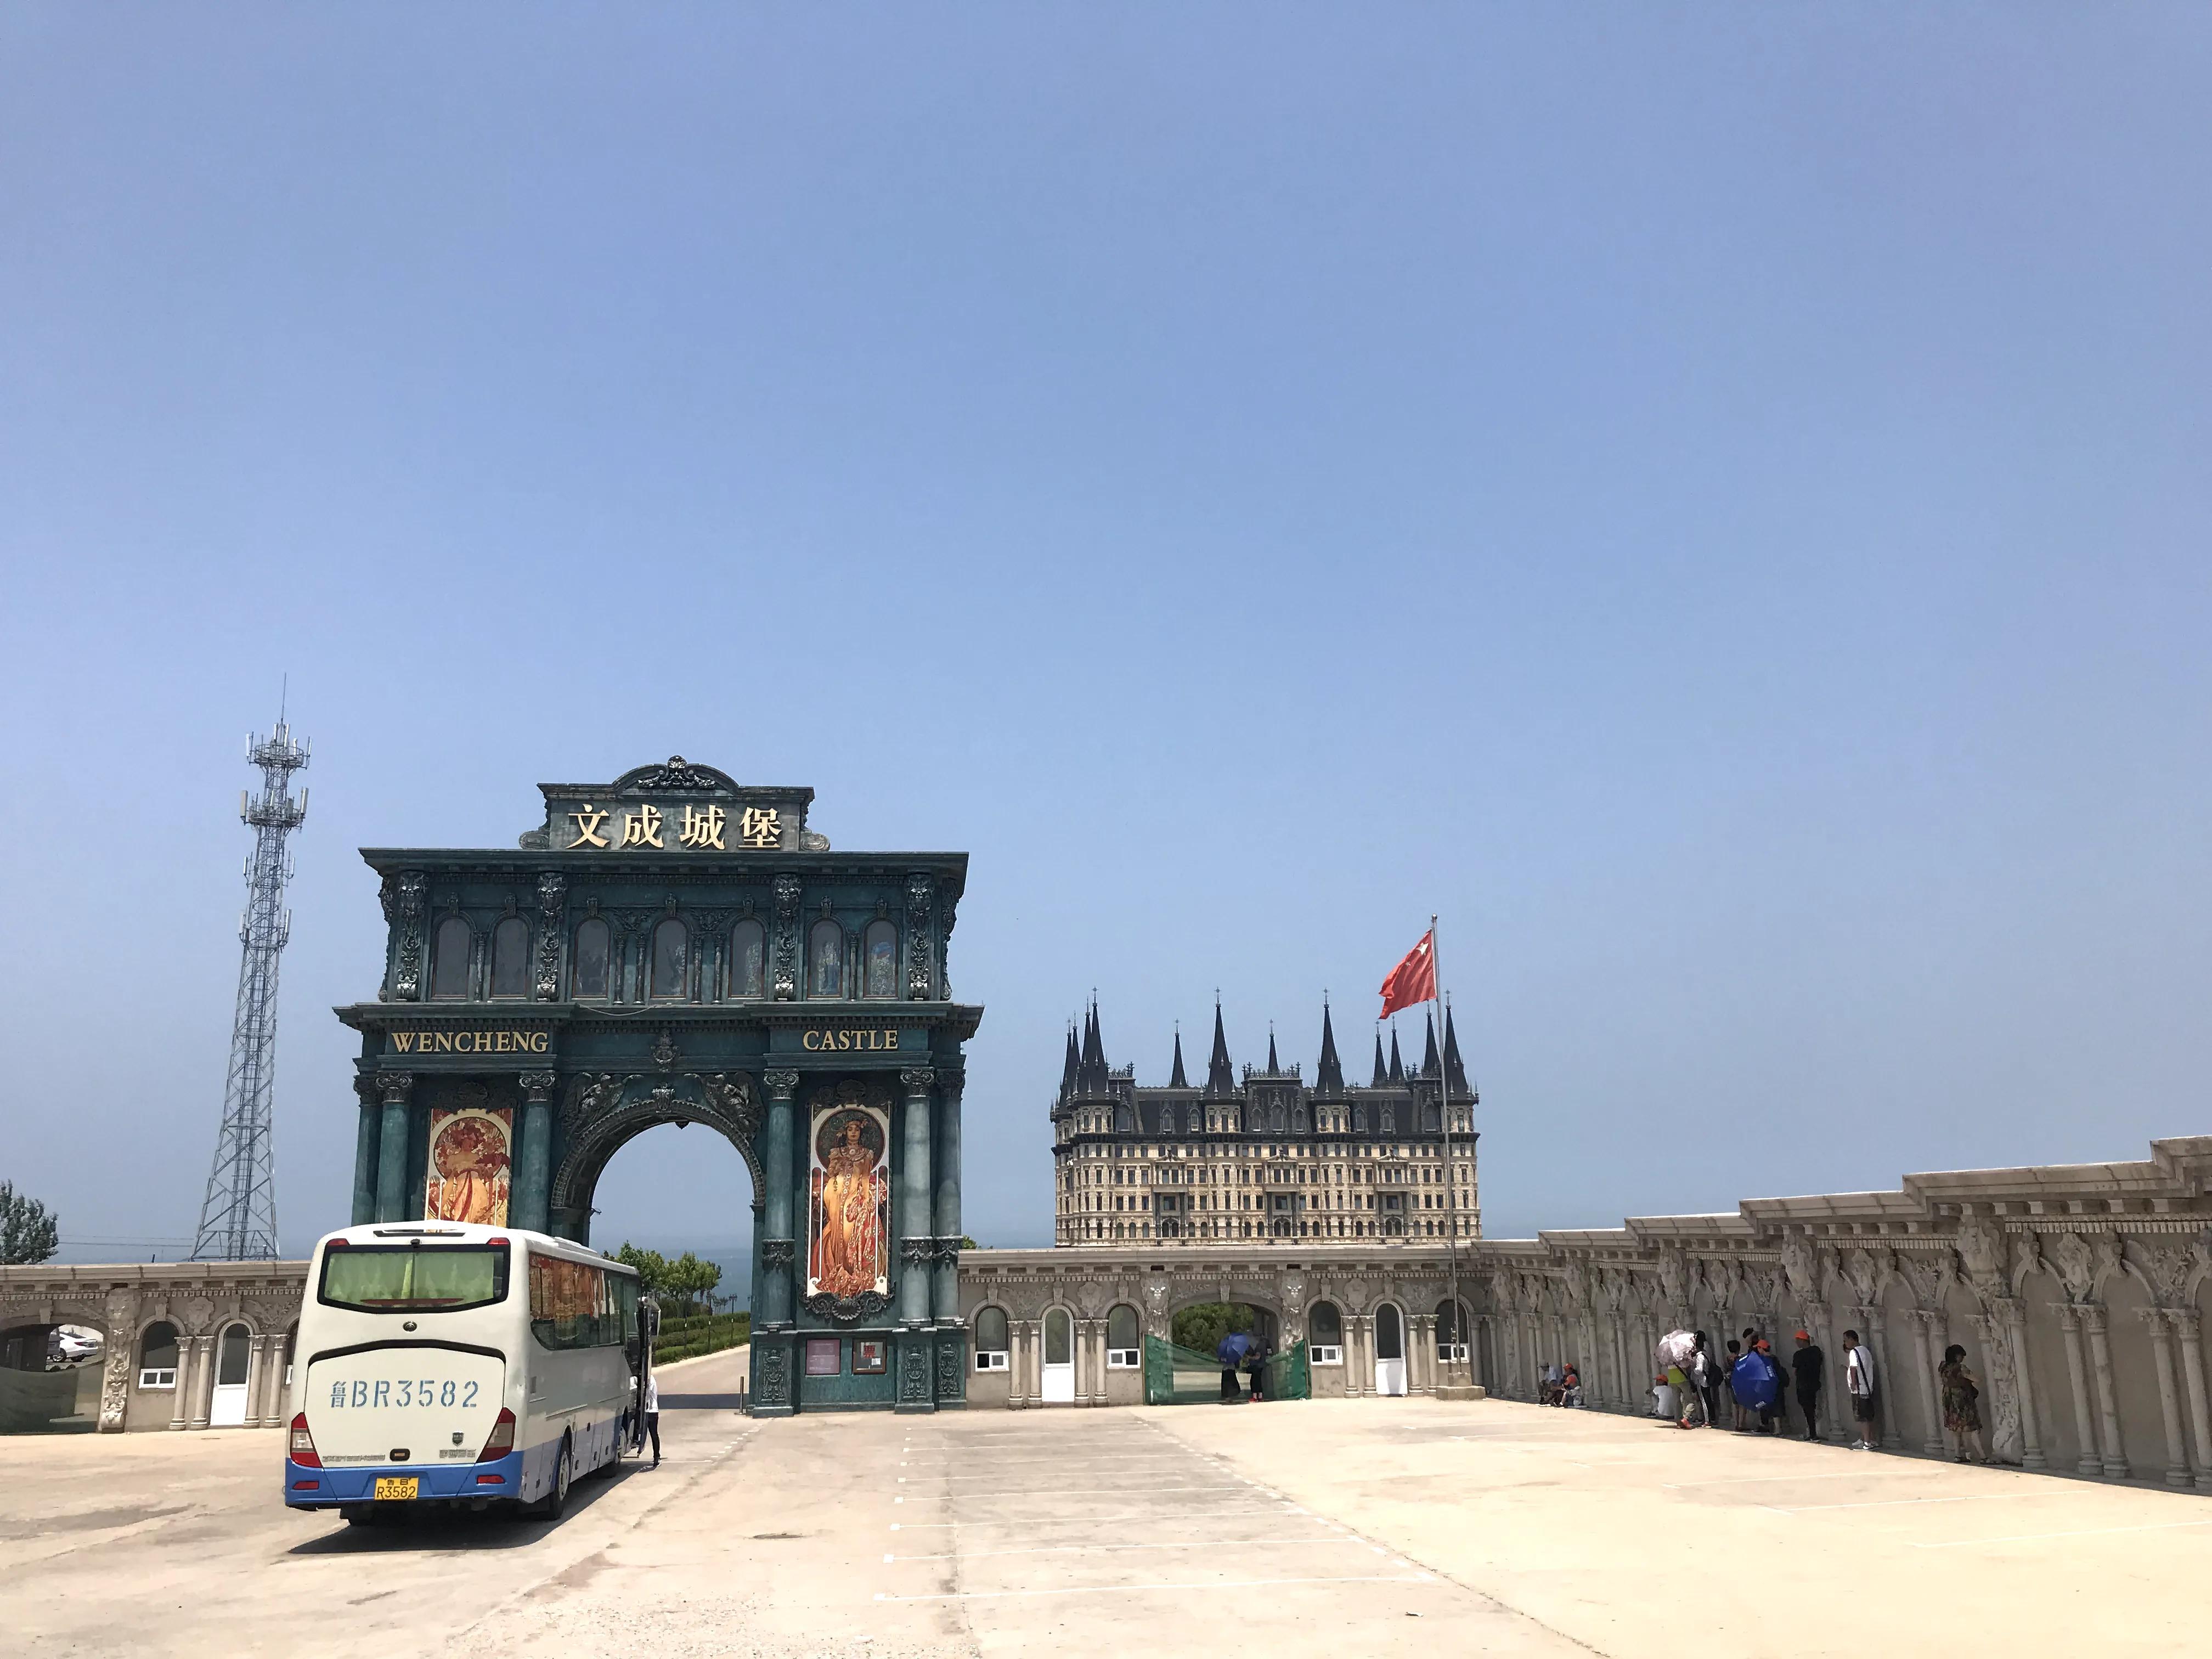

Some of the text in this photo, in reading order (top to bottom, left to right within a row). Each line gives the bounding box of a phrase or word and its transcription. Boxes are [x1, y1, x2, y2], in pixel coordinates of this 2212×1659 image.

[566, 803, 783, 850] 文成城堡
[391, 1030, 898, 1052] WENCHENG CASTLE
[330, 1380, 478, 1408] 鲁BR3582
[376, 1486, 416, 1498] R3582
